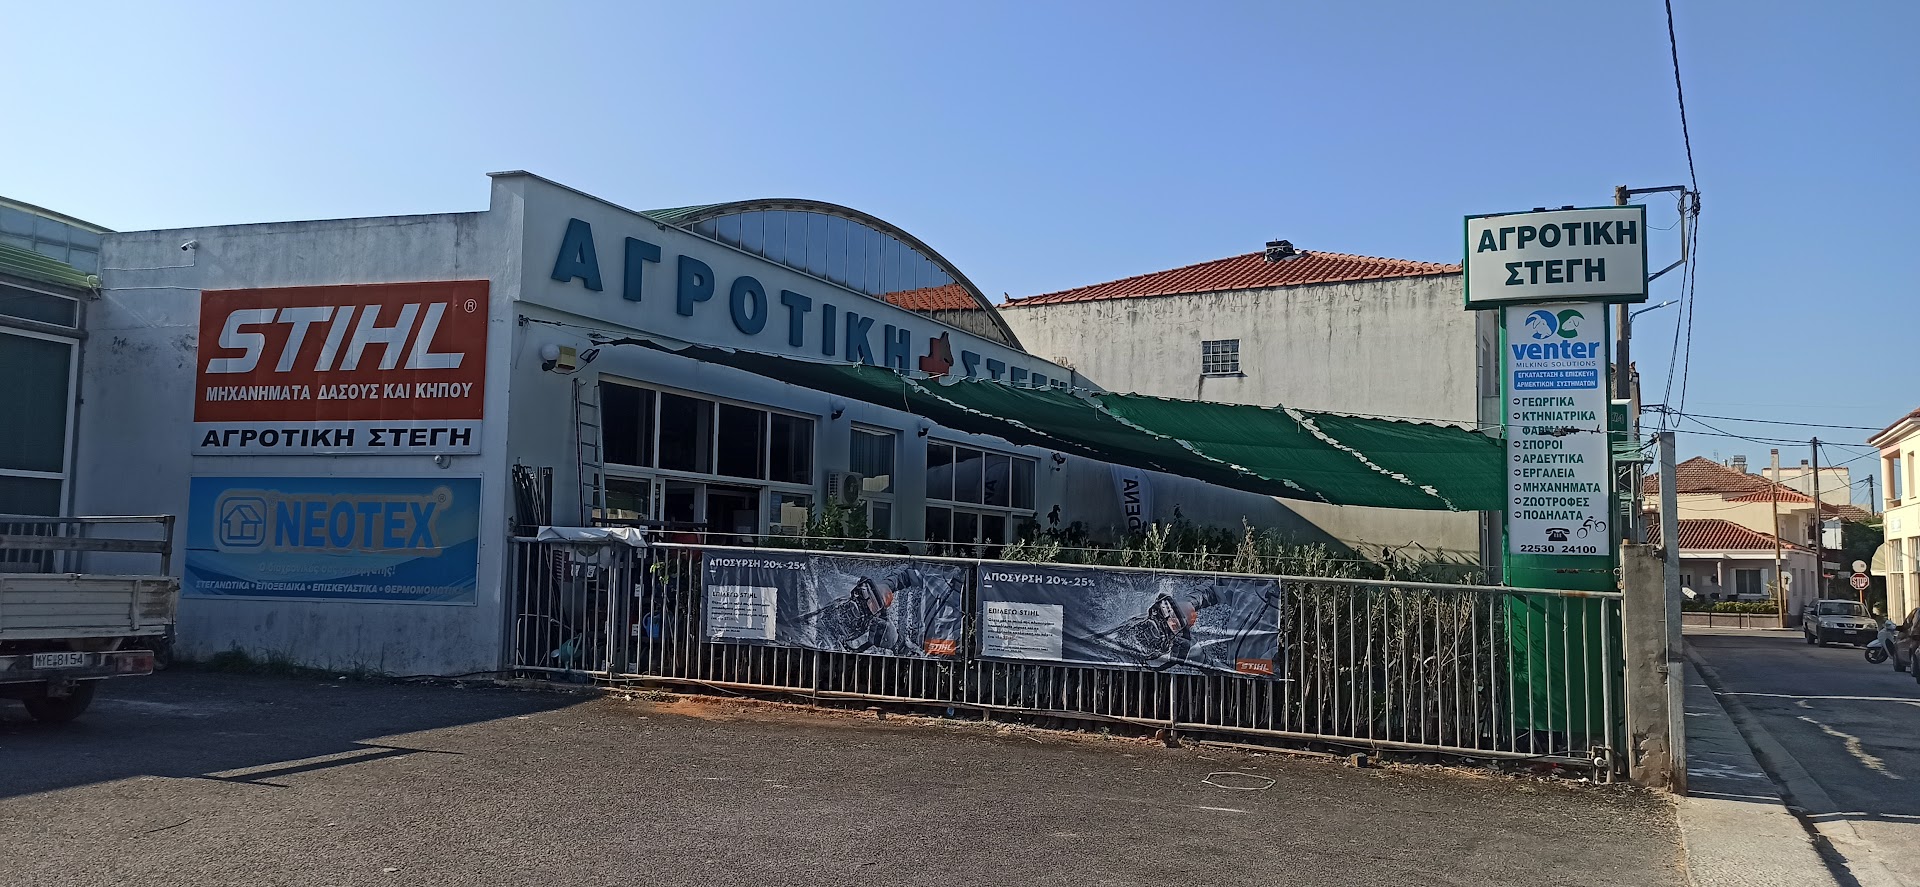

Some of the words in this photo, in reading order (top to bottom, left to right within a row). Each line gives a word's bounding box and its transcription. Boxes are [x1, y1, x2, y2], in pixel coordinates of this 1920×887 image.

[1477, 220, 1637, 253] ΑΓΡΟΤΙΚΗ
[1505, 257, 1606, 286] ΣΤΕΓΗ
[551, 217, 911, 377] ΑΓΡΟΤΙΚΗ
[205, 302, 466, 374] STIHL
[1512, 340, 1600, 361] venter
[205, 384, 311, 402] ΜΗΧΑΝΗΜΑΤΑ
[317, 383, 380, 400] ΔΑΣΟΥΣ
[383, 383, 410, 399] ΚΑΙ
[415, 382, 473, 399] ΚΗΠΟΥ
[1522, 397, 1575, 406] ΓΕΩΡΓΙΚΑ
[1522, 411, 1596, 421] ΚΤΗΝΙΑΤΡΙΚΑ
[201, 429, 354, 447] ΑΓΡΟΤΙΚΗ
[368, 428, 472, 447] ΣΤΕΓΗ
[1522, 440, 1563, 450] ΣΠΟΡΟΙ
[1522, 453, 1584, 464] ΑΡΔΕΥΤΙΚΑ
[1523, 468, 1575, 478] ΕΡΓΑΛΕΙΑ
[1523, 482, 1601, 493] ΜΗΧΑΝΗΜΑΤΑ
[1523, 497, 1590, 507] ΖΩΟΤΡΟΦΕΣ
[1523, 510, 1584, 521] ΠΟΔΗΛΑΤΑ
[275, 501, 437, 549] NEOTEX
[1520, 545, 1555, 553] 22530
[1561, 545, 1597, 554] 24100
[709, 558, 760, 568] ΑΠΟΣΥΡΣΗ
[983, 572, 1043, 584] ΑΠΟΣΥΡΣΗ
[1852, 577, 1868, 587] STOP
[196, 581, 250, 590] ΣΤΕΓΑΝΩΤΙΚΑ
[256, 582, 306, 591] ΕΠΟΞΕΙΔΙΚΑ
[312, 583, 378, 594] ΕΠΙΣΚΕΥΑΣΤΙΚΑ
[1019, 609, 1040, 617] STIHL
[928, 643, 952, 652] STIHL
[1241, 662, 1270, 671] STIHL
